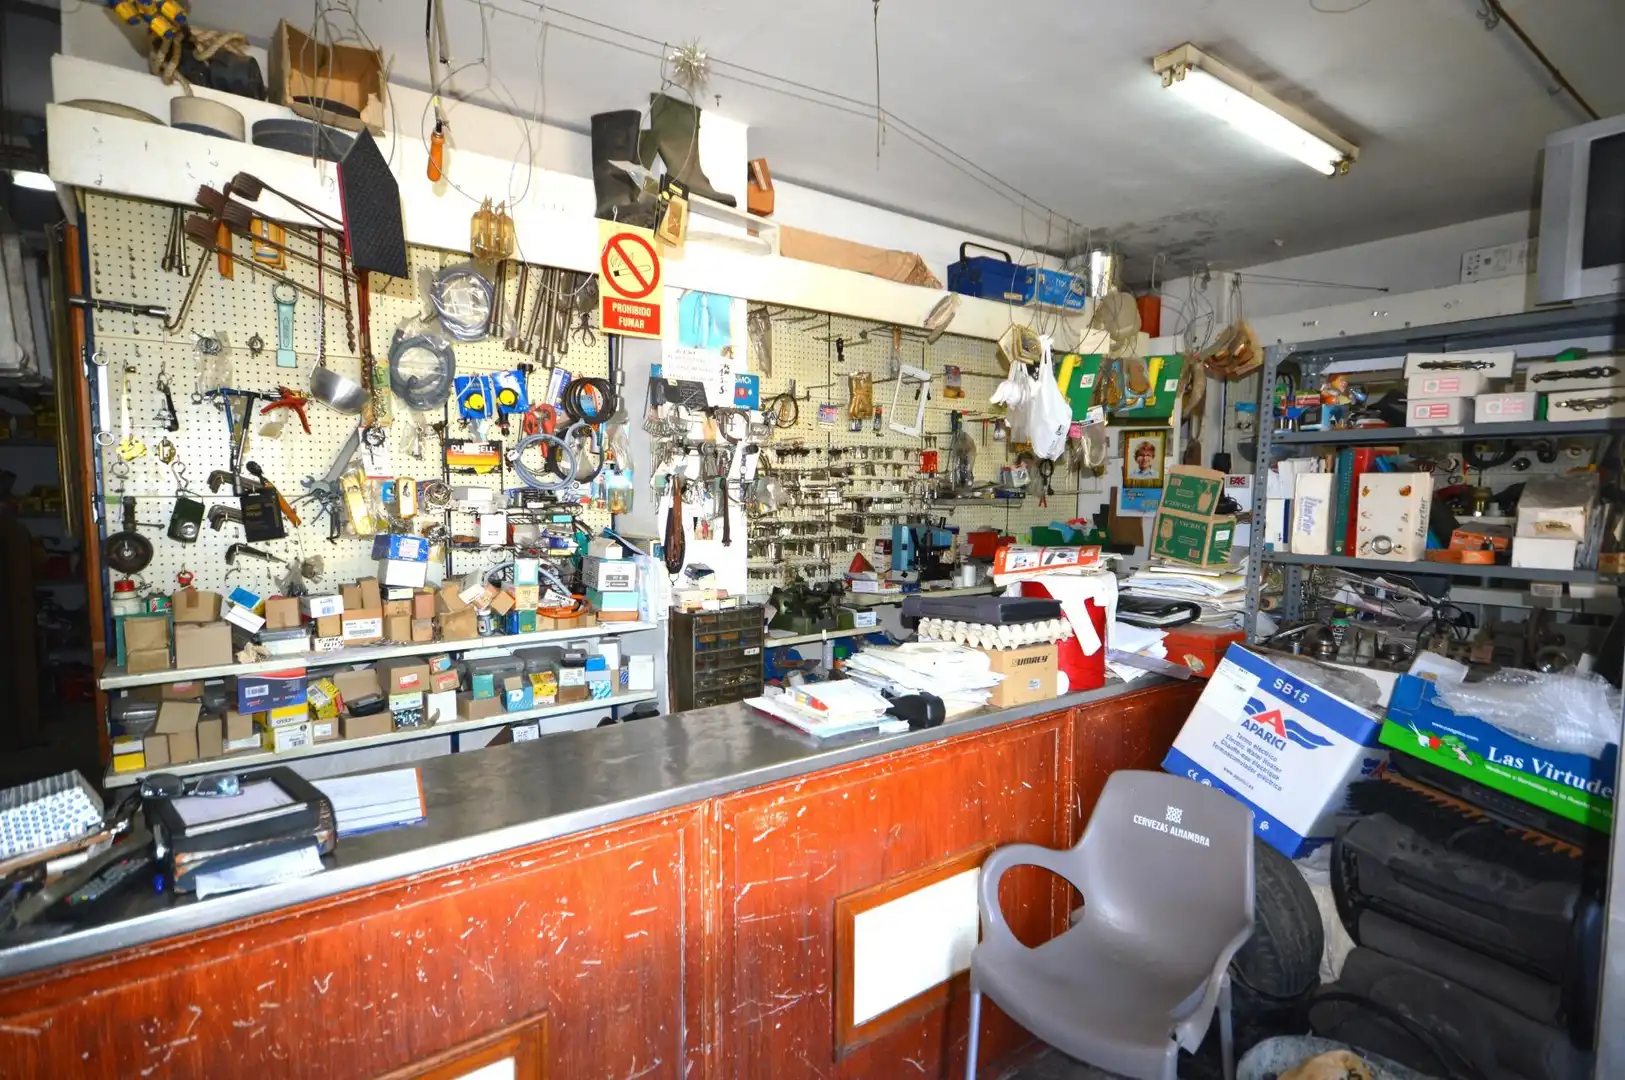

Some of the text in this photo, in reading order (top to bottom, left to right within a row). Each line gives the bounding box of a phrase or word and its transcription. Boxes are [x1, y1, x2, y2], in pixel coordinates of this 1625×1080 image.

[612, 301, 652, 317] PROHIBIDO
[618, 316, 645, 329] FUMAR
[451, 444, 494, 453] DUELL
[1273, 677, 1310, 704] SB15
[1241, 718, 1287, 751] APARICI
[1487, 745, 1524, 769] Las
[1133, 814, 1210, 847] CERVEZAS ALHAMBRA
